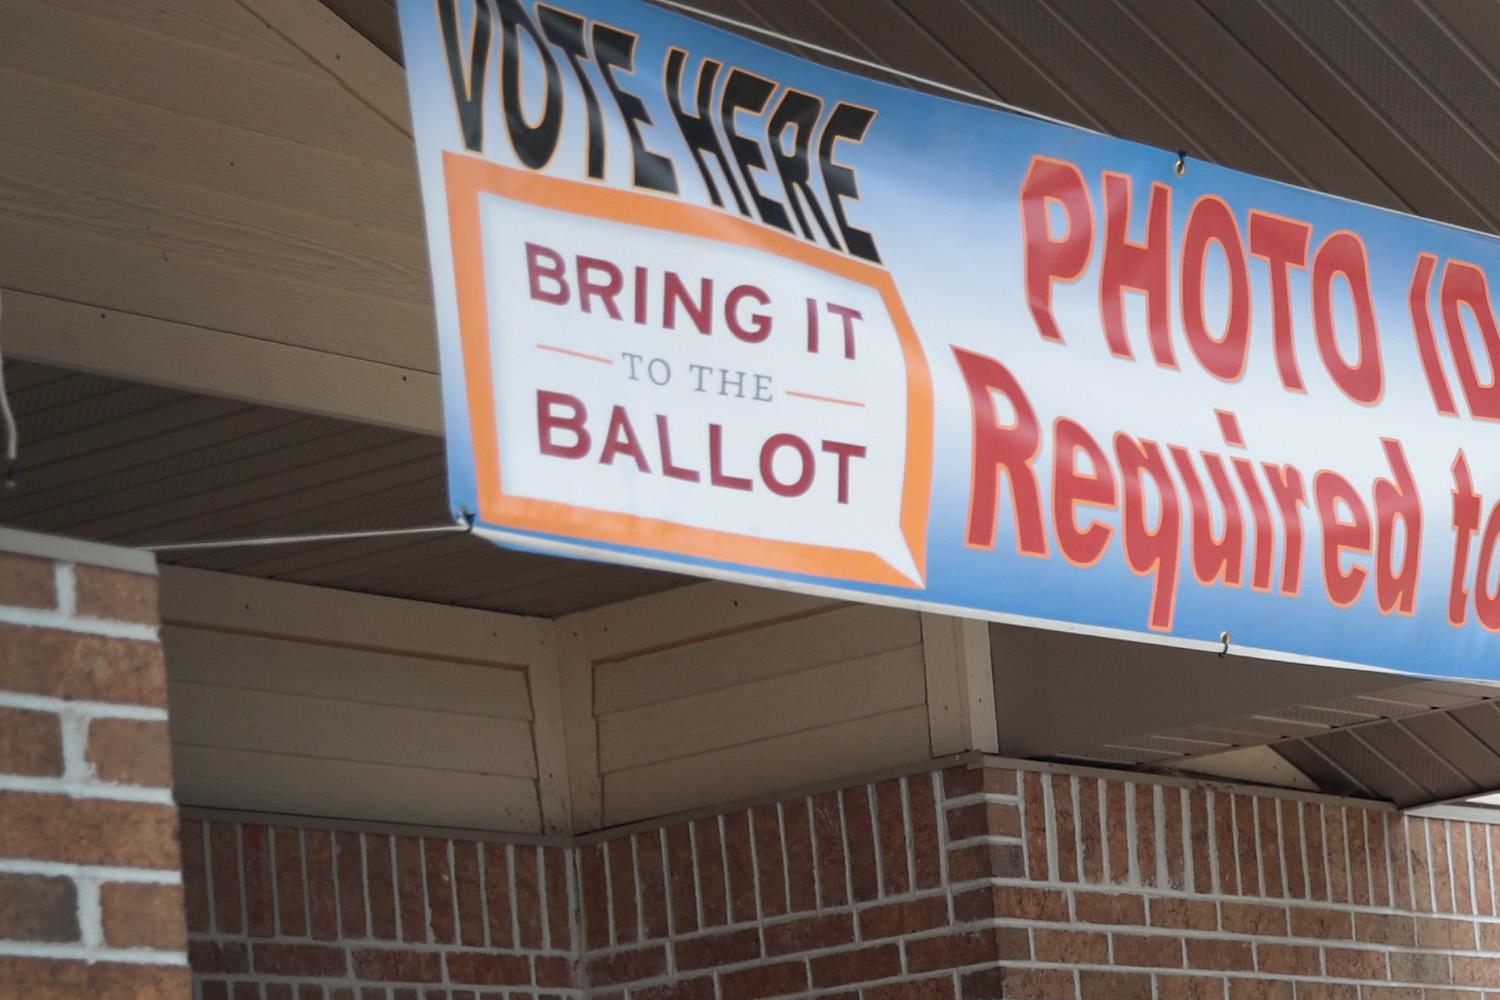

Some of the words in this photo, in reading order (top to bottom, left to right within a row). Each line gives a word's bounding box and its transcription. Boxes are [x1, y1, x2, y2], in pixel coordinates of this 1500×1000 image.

[435, 0, 680, 195] VOTE
[663, 46, 885, 266] HERE
[525, 240, 773, 345] BRING
[806, 296, 864, 361] IT
[1019, 154, 1386, 407] PHOTO
[535, 389, 867, 505] BALLOT
[621, 352, 672, 387] TO
[689, 363, 774, 403] THE
[949, 344, 1424, 634] Required
